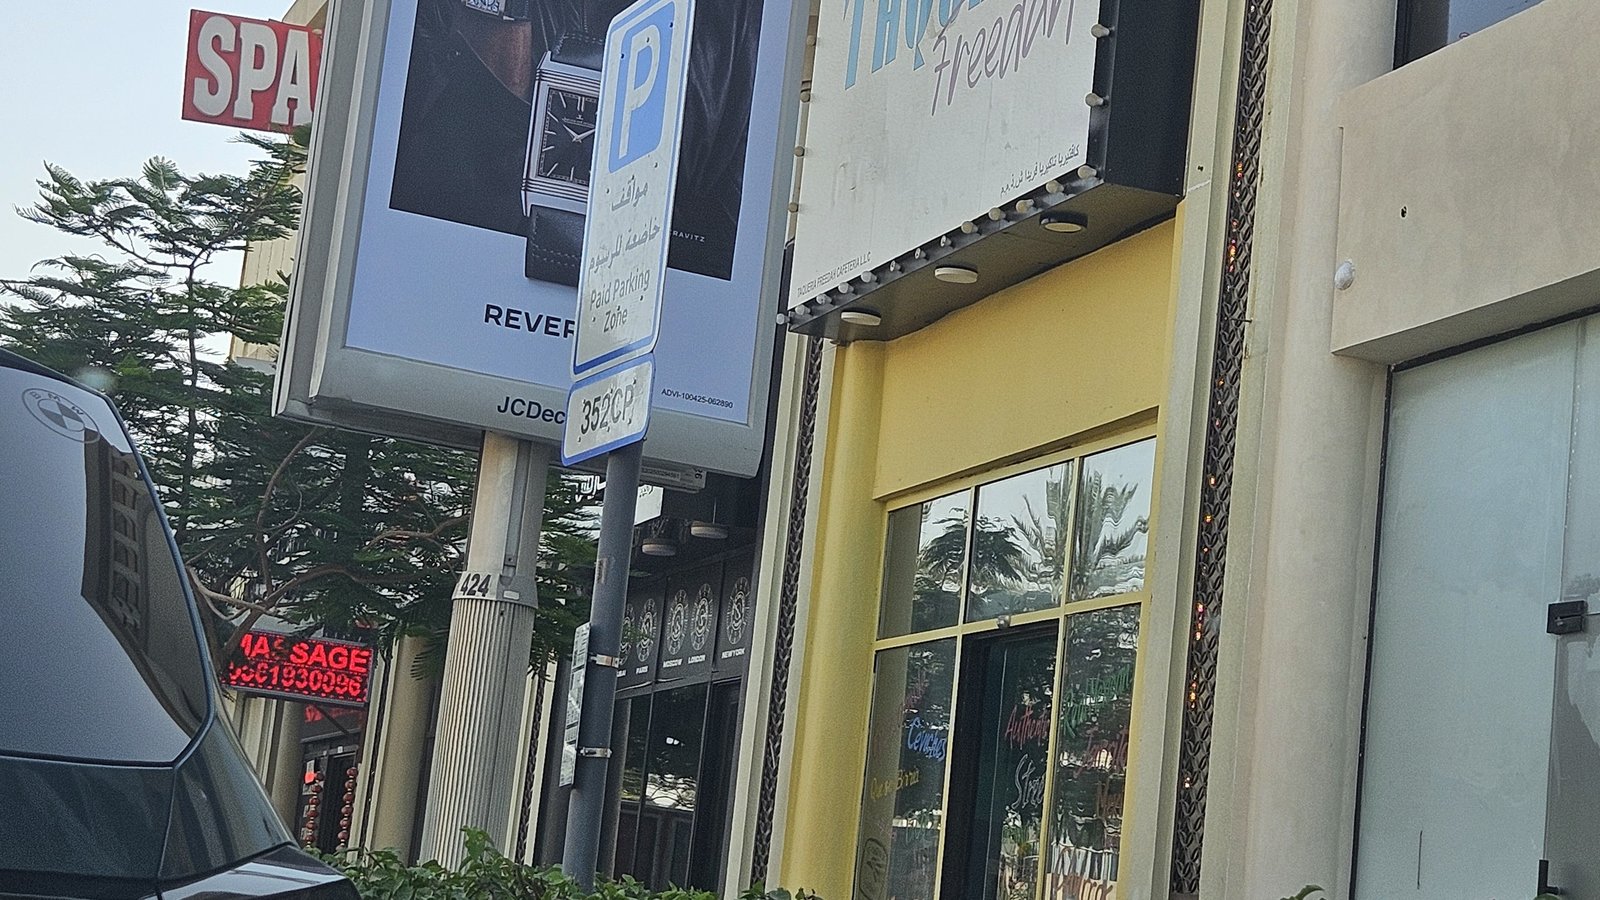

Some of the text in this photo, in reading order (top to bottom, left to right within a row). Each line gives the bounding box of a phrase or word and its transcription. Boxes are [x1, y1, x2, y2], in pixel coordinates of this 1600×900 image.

[843, 0, 985, 91] TAQ
[192, 15, 313, 126] SPA
[618, 24, 661, 160] P
[611, 178, 649, 212] مواقف
[588, 217, 660, 274] خاضعة للرسوم
[672, 230, 705, 243] RAVITZ
[589, 268, 650, 311] Paid Parking
[484, 304, 576, 339] REVER
[603, 308, 628, 333] Zone
[497, 396, 566, 425] JCDec
[581, 384, 634, 435] 352CP
[460, 573, 491, 597] 424
[1012, 753, 1046, 810] Stree
